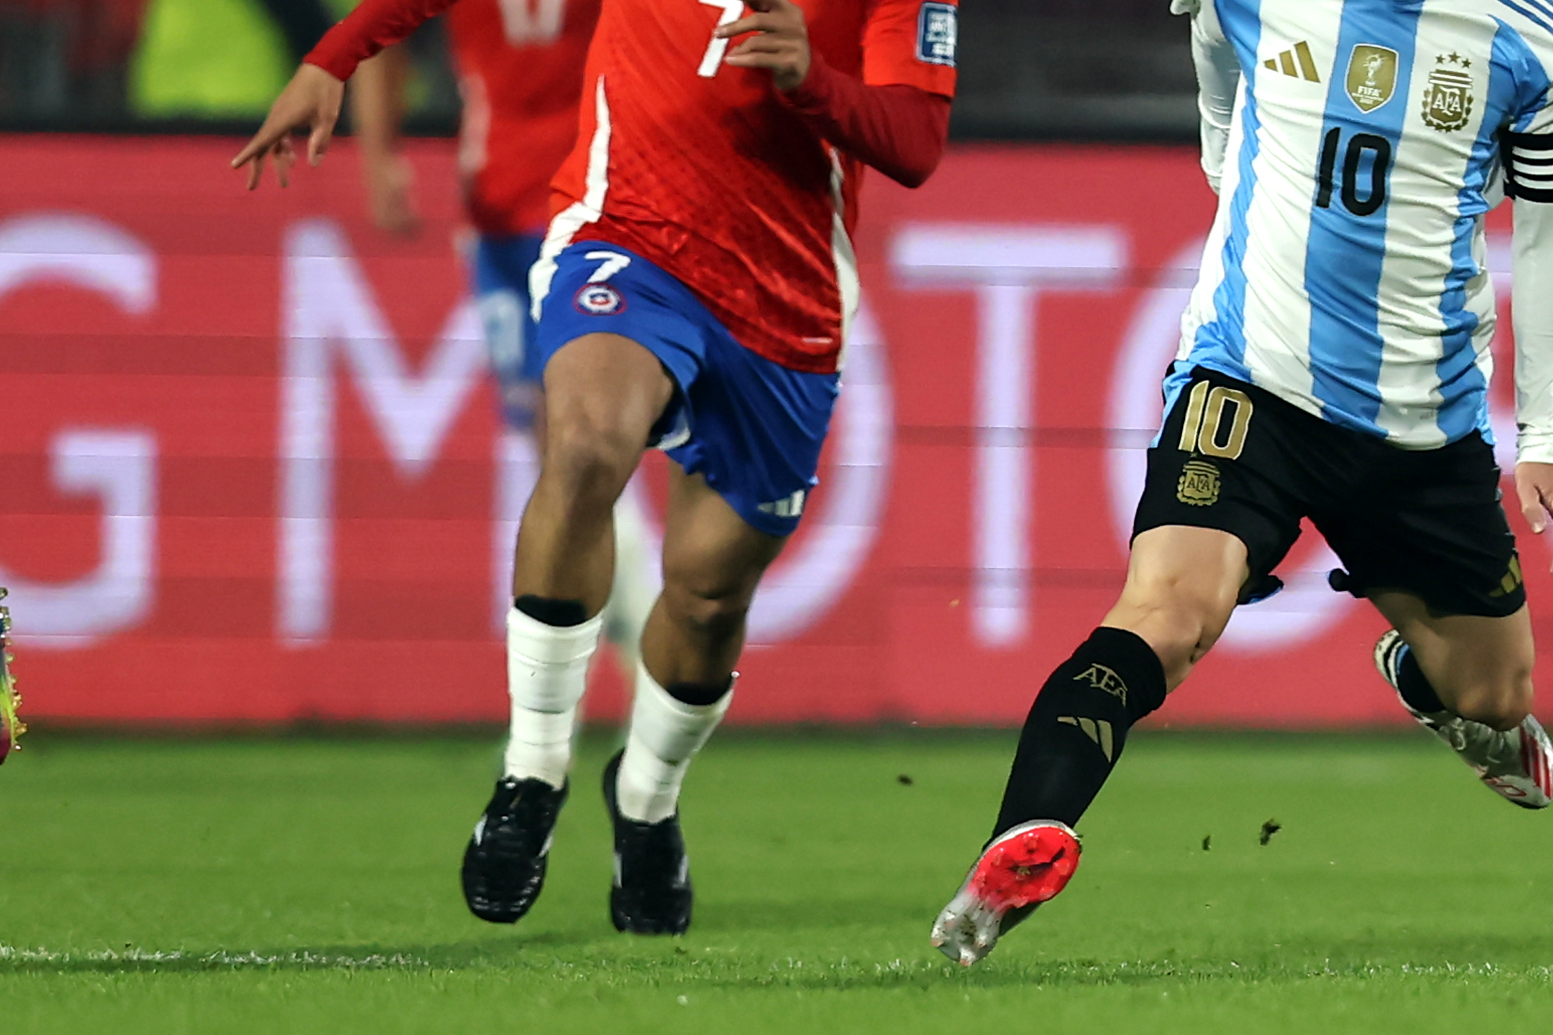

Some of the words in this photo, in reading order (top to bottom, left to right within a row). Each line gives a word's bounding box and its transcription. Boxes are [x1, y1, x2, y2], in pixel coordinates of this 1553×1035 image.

[1357, 85, 1382, 98] FIFA
[1432, 85, 1462, 116] AFA
[1315, 126, 1391, 217] 10
[584, 250, 631, 284] 7
[1178, 380, 1254, 460] 10
[1186, 471, 1211, 493] AFA
[1073, 663, 1128, 708] AFA
